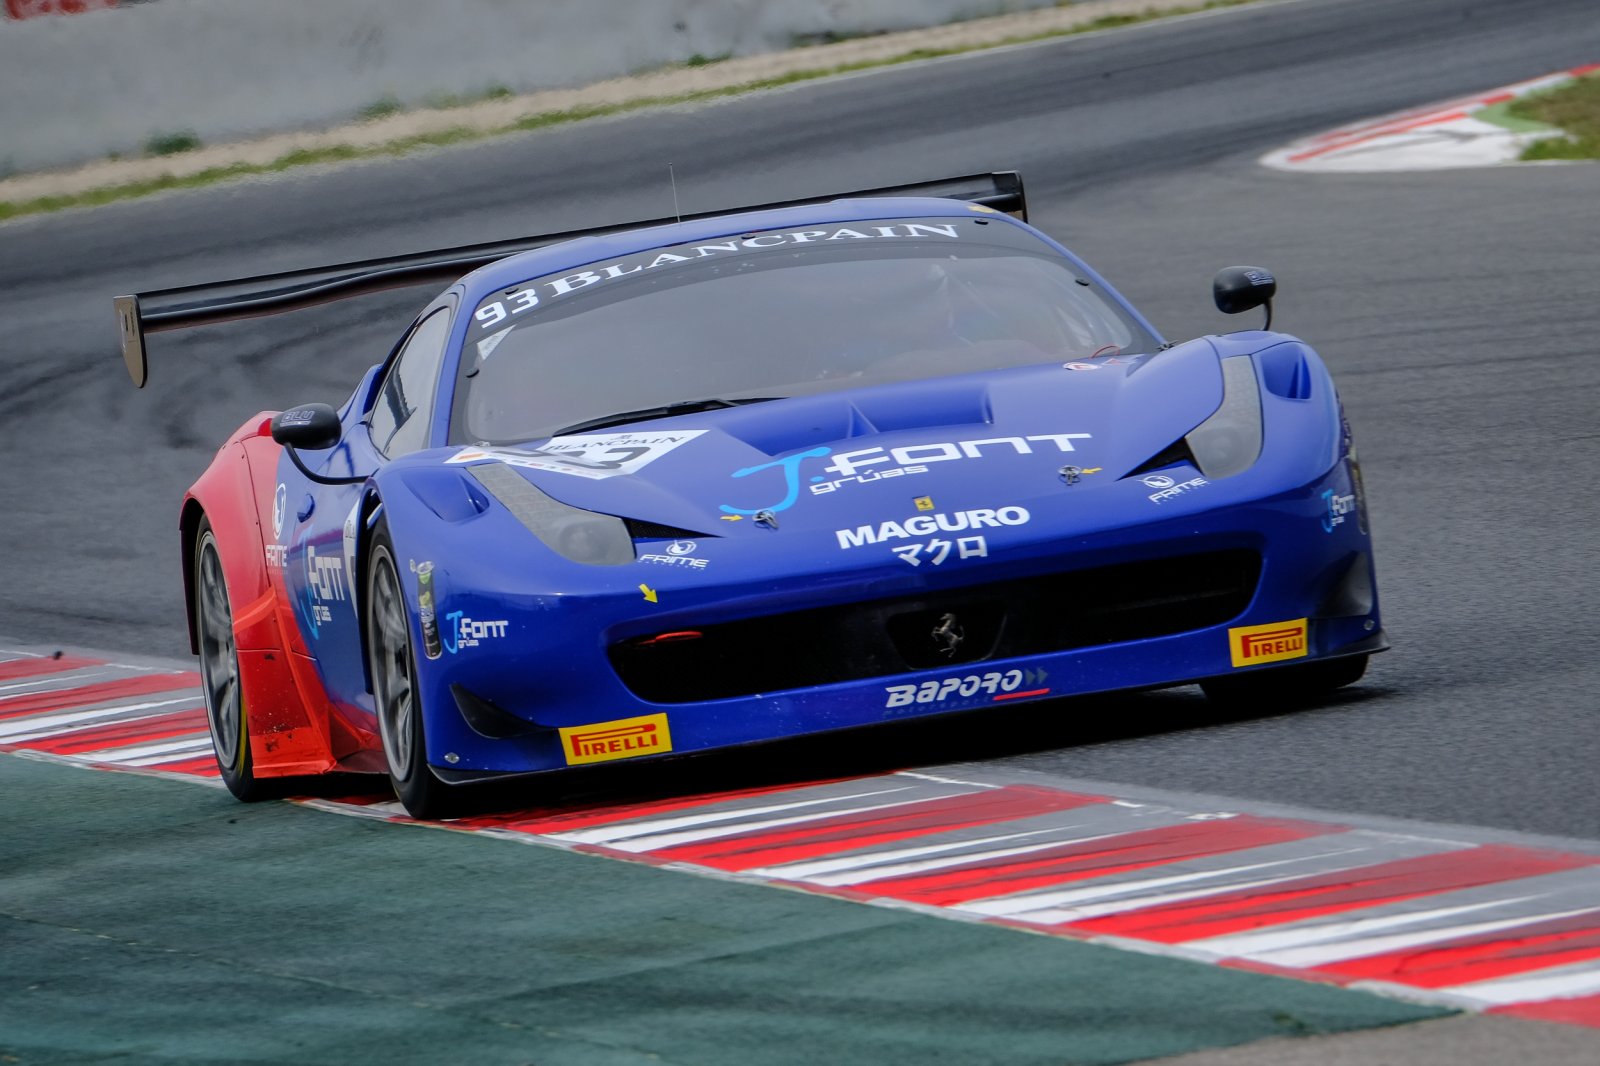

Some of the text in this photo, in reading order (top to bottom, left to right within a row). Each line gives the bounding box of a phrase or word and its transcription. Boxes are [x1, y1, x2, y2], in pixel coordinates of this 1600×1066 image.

[475, 223, 960, 329] 93 BLANCPAIN
[836, 506, 1030, 549] MAGURO
[892, 535, 988, 567] マクロ
[1241, 626, 1303, 658] PIRELLI
[570, 723, 658, 757] PIRELLI
